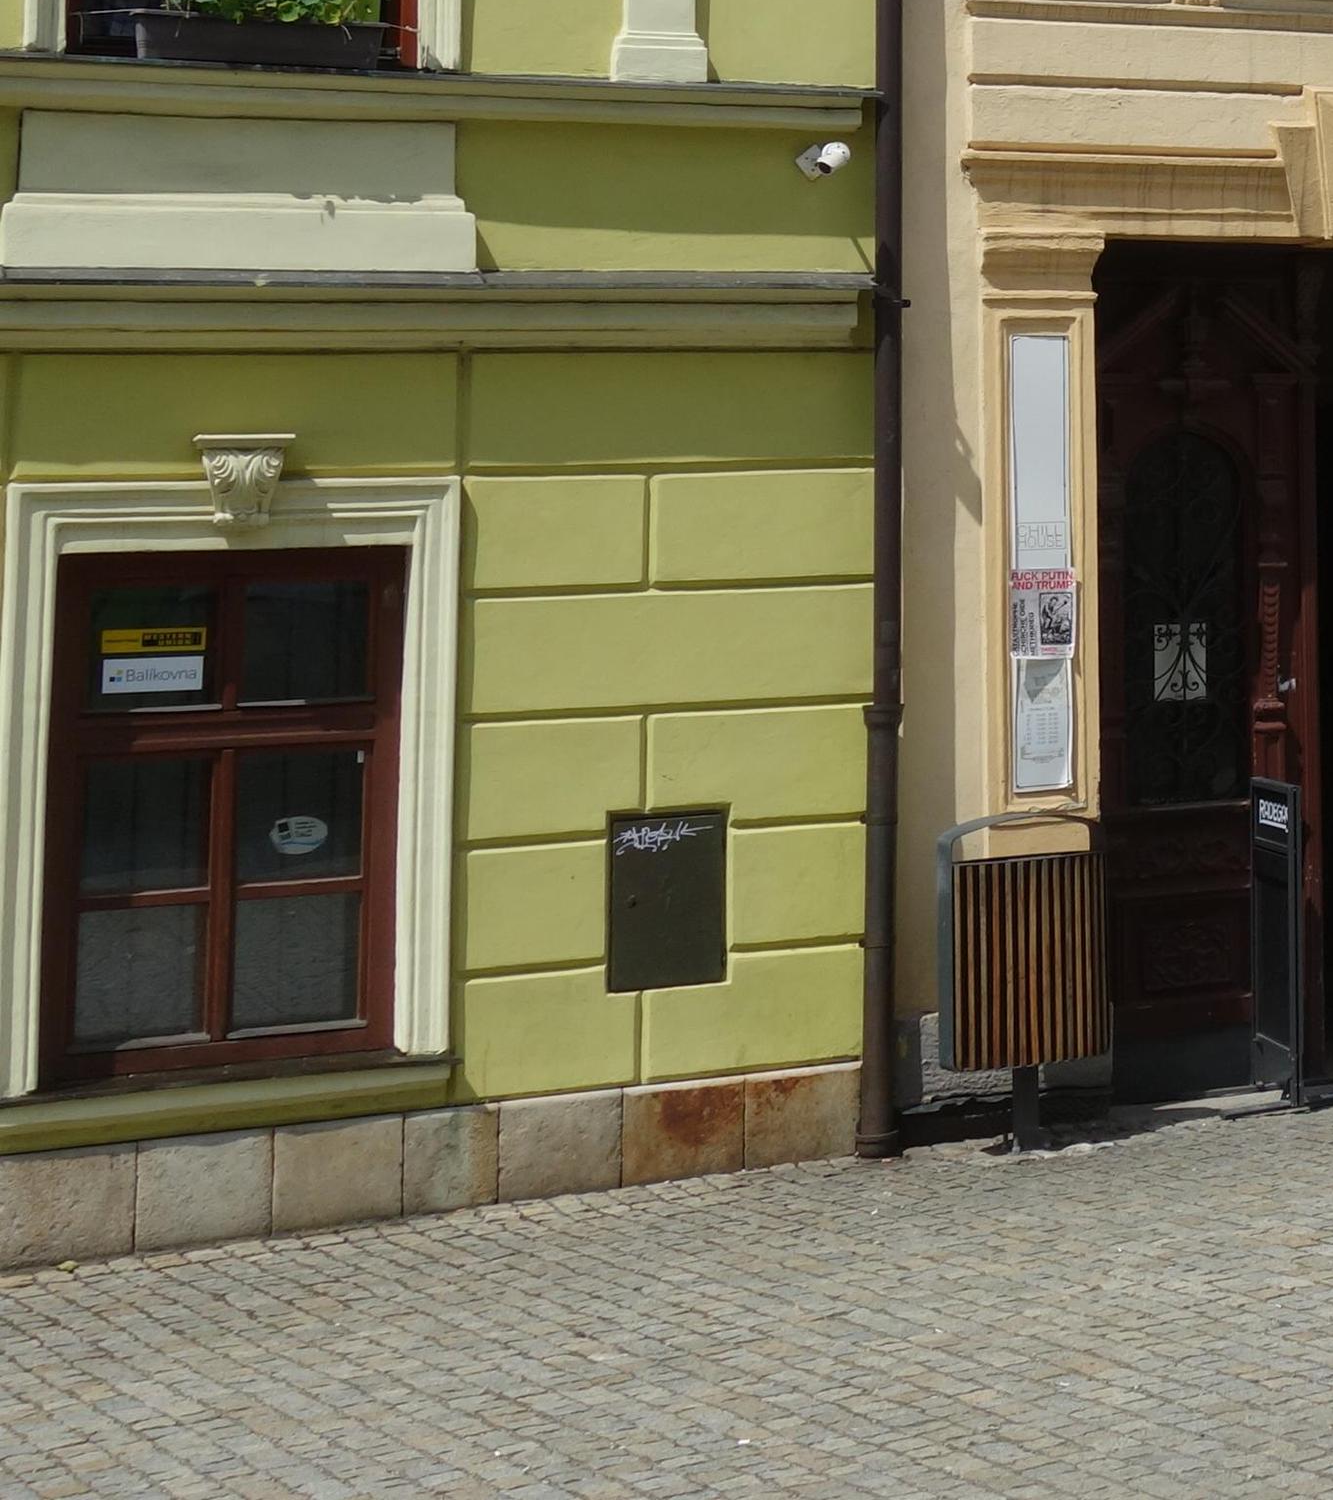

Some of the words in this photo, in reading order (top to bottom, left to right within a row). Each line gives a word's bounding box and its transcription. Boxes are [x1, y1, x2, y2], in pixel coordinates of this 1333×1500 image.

[1018, 535, 1062, 548] HOUSE
[1011, 571, 1039, 582] FUCK
[1041, 570, 1074, 581] PUTIN
[1011, 581, 1033, 591] AND
[1036, 580, 1074, 590] TRUMP
[126, 667, 198, 683] Balíkovna
